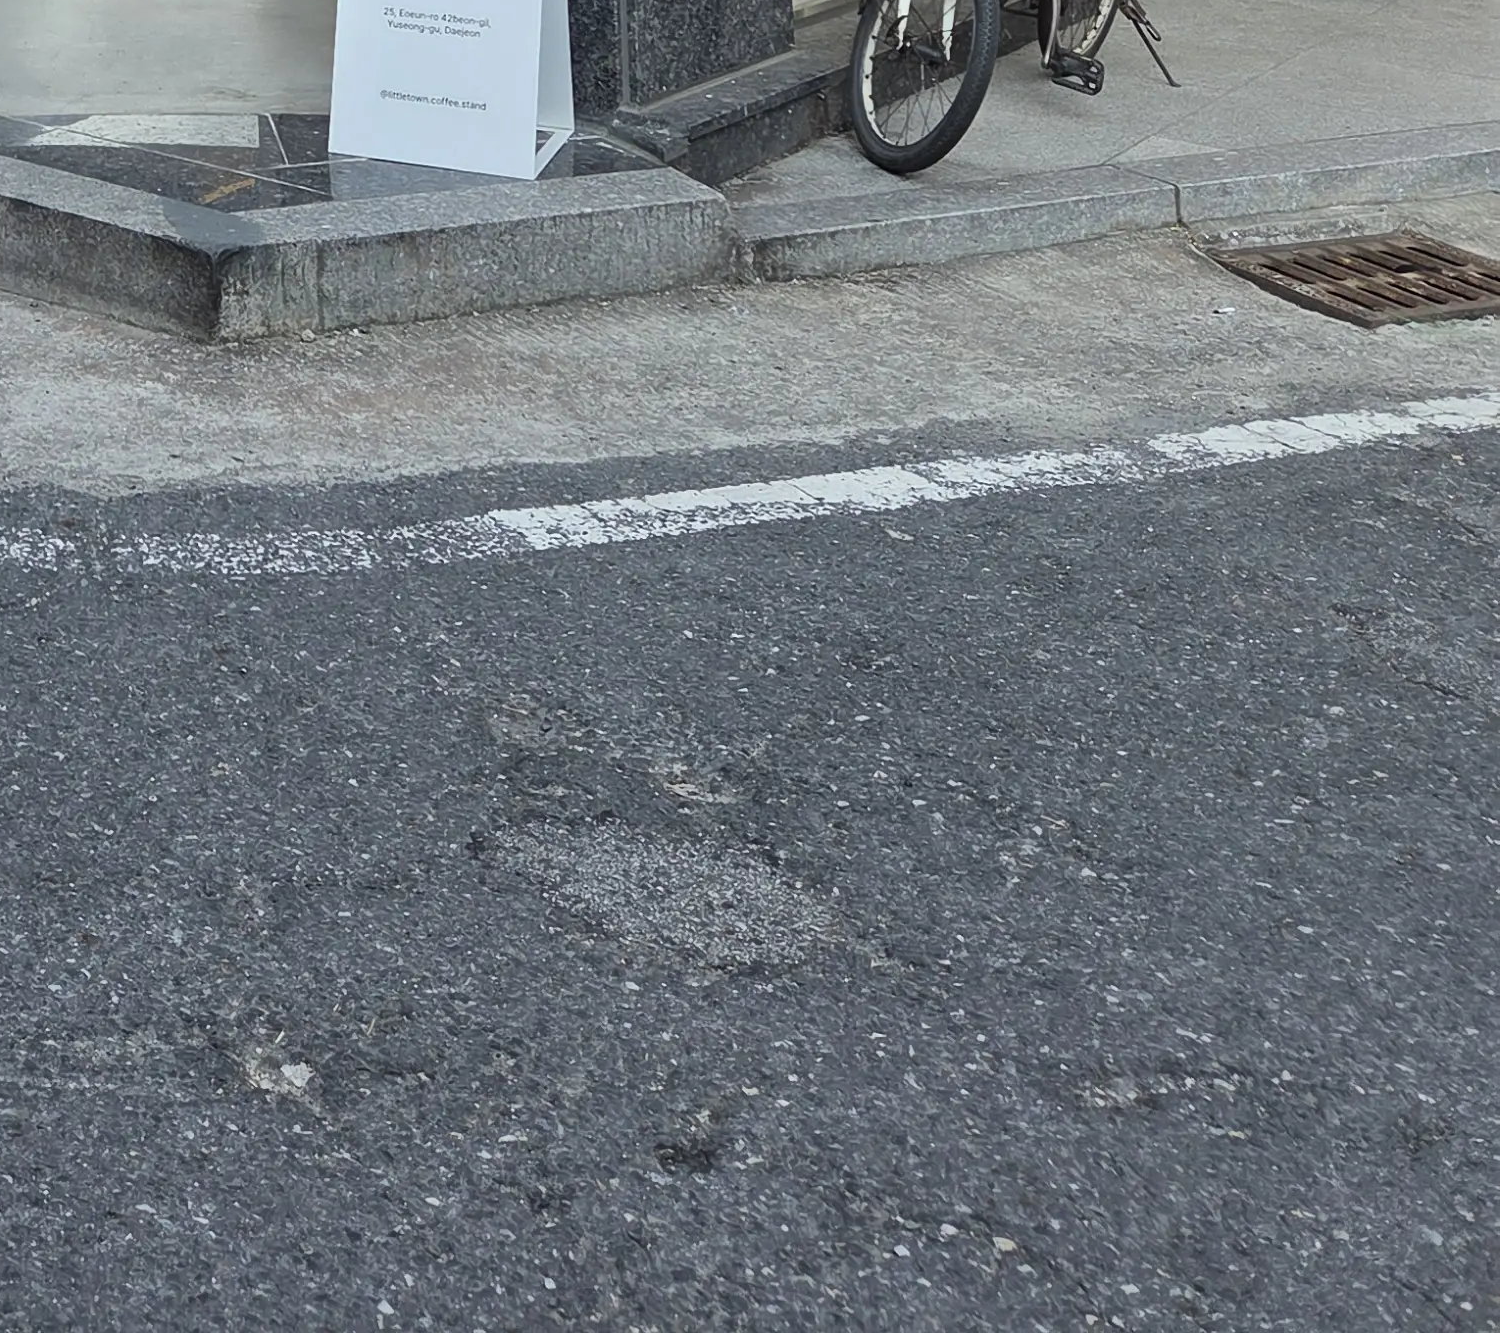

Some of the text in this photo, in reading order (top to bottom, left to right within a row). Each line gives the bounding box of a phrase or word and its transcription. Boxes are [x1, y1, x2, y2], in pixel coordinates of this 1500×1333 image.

[383, 7, 397, 18] 25,
[387, 19, 481, 38] Yuseong-gu, Daejeon
